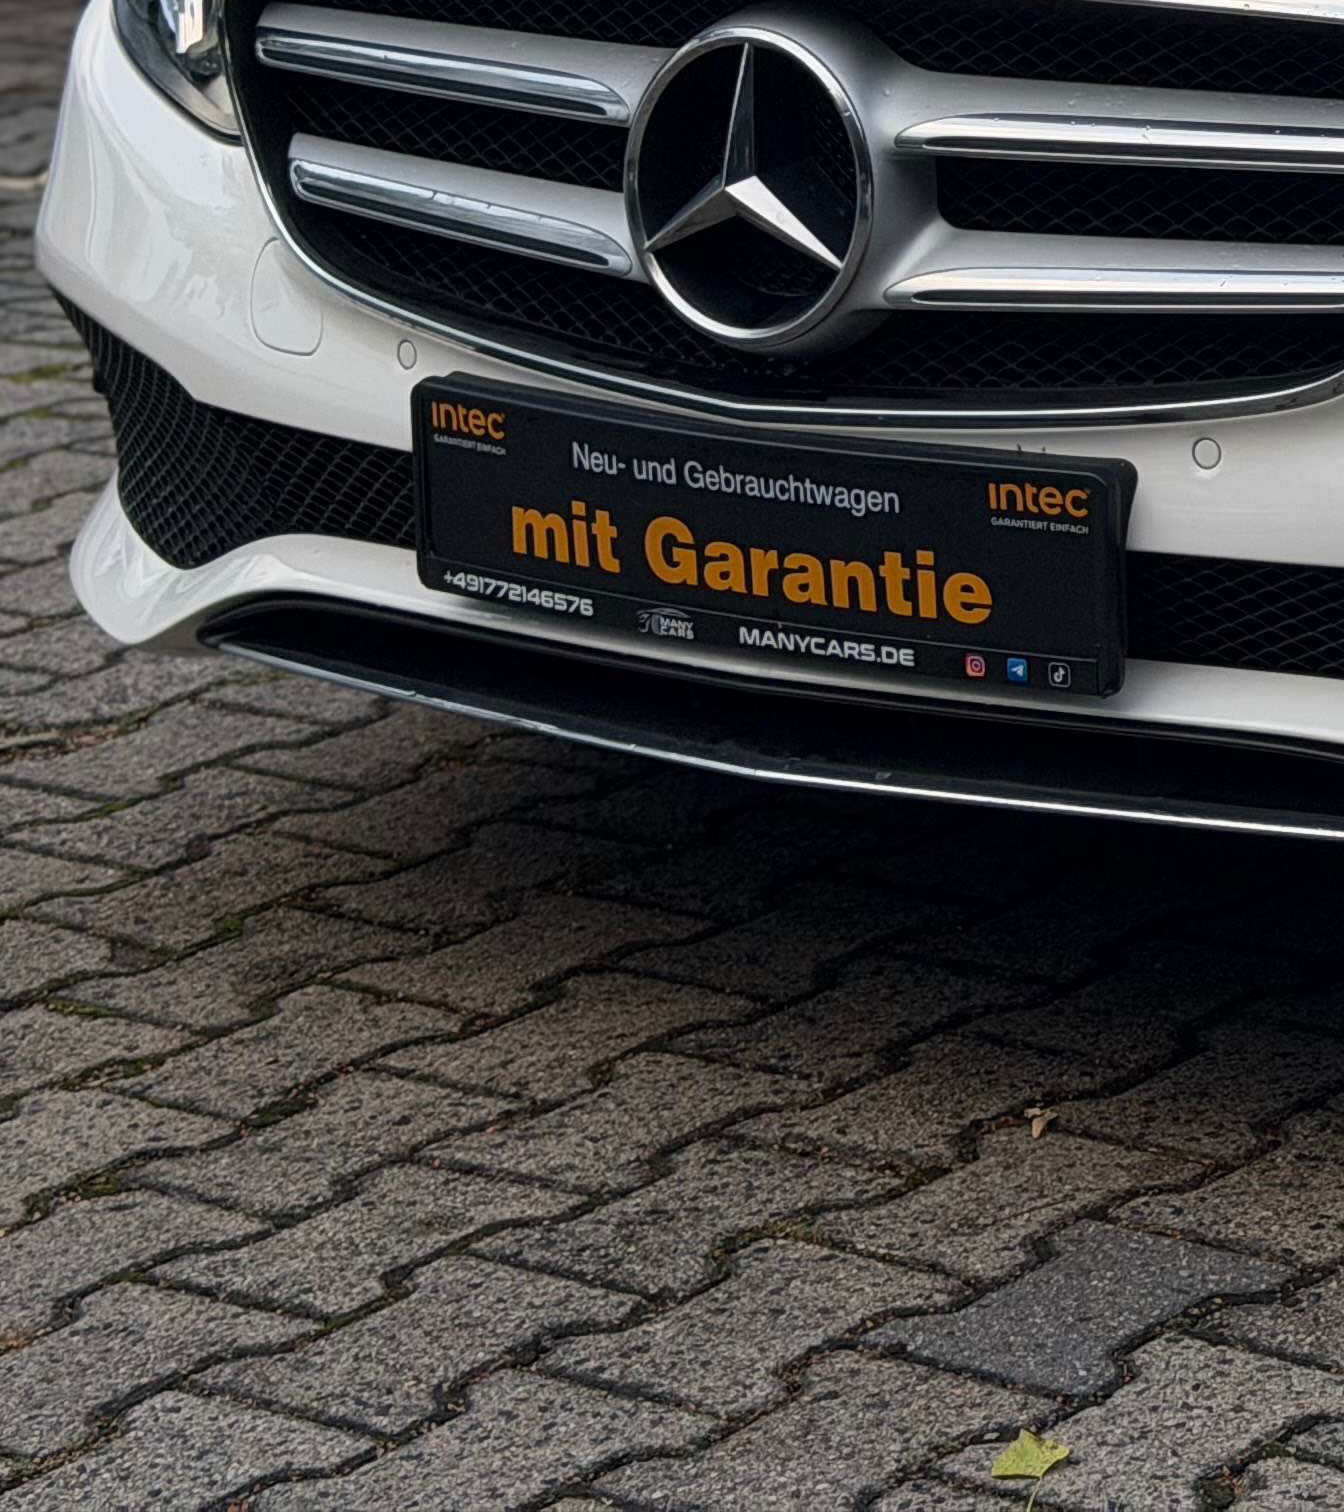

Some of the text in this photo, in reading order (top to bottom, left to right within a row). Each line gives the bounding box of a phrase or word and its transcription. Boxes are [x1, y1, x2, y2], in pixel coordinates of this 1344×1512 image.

[571, 441, 900, 517] Neu- und Gebrauchtwagen
[511, 500, 993, 625] mit Garantie
[443, 570, 594, 617] +491772146576
[660, 616, 694, 631] MANY
[739, 626, 916, 668] MANYCARS.DE
